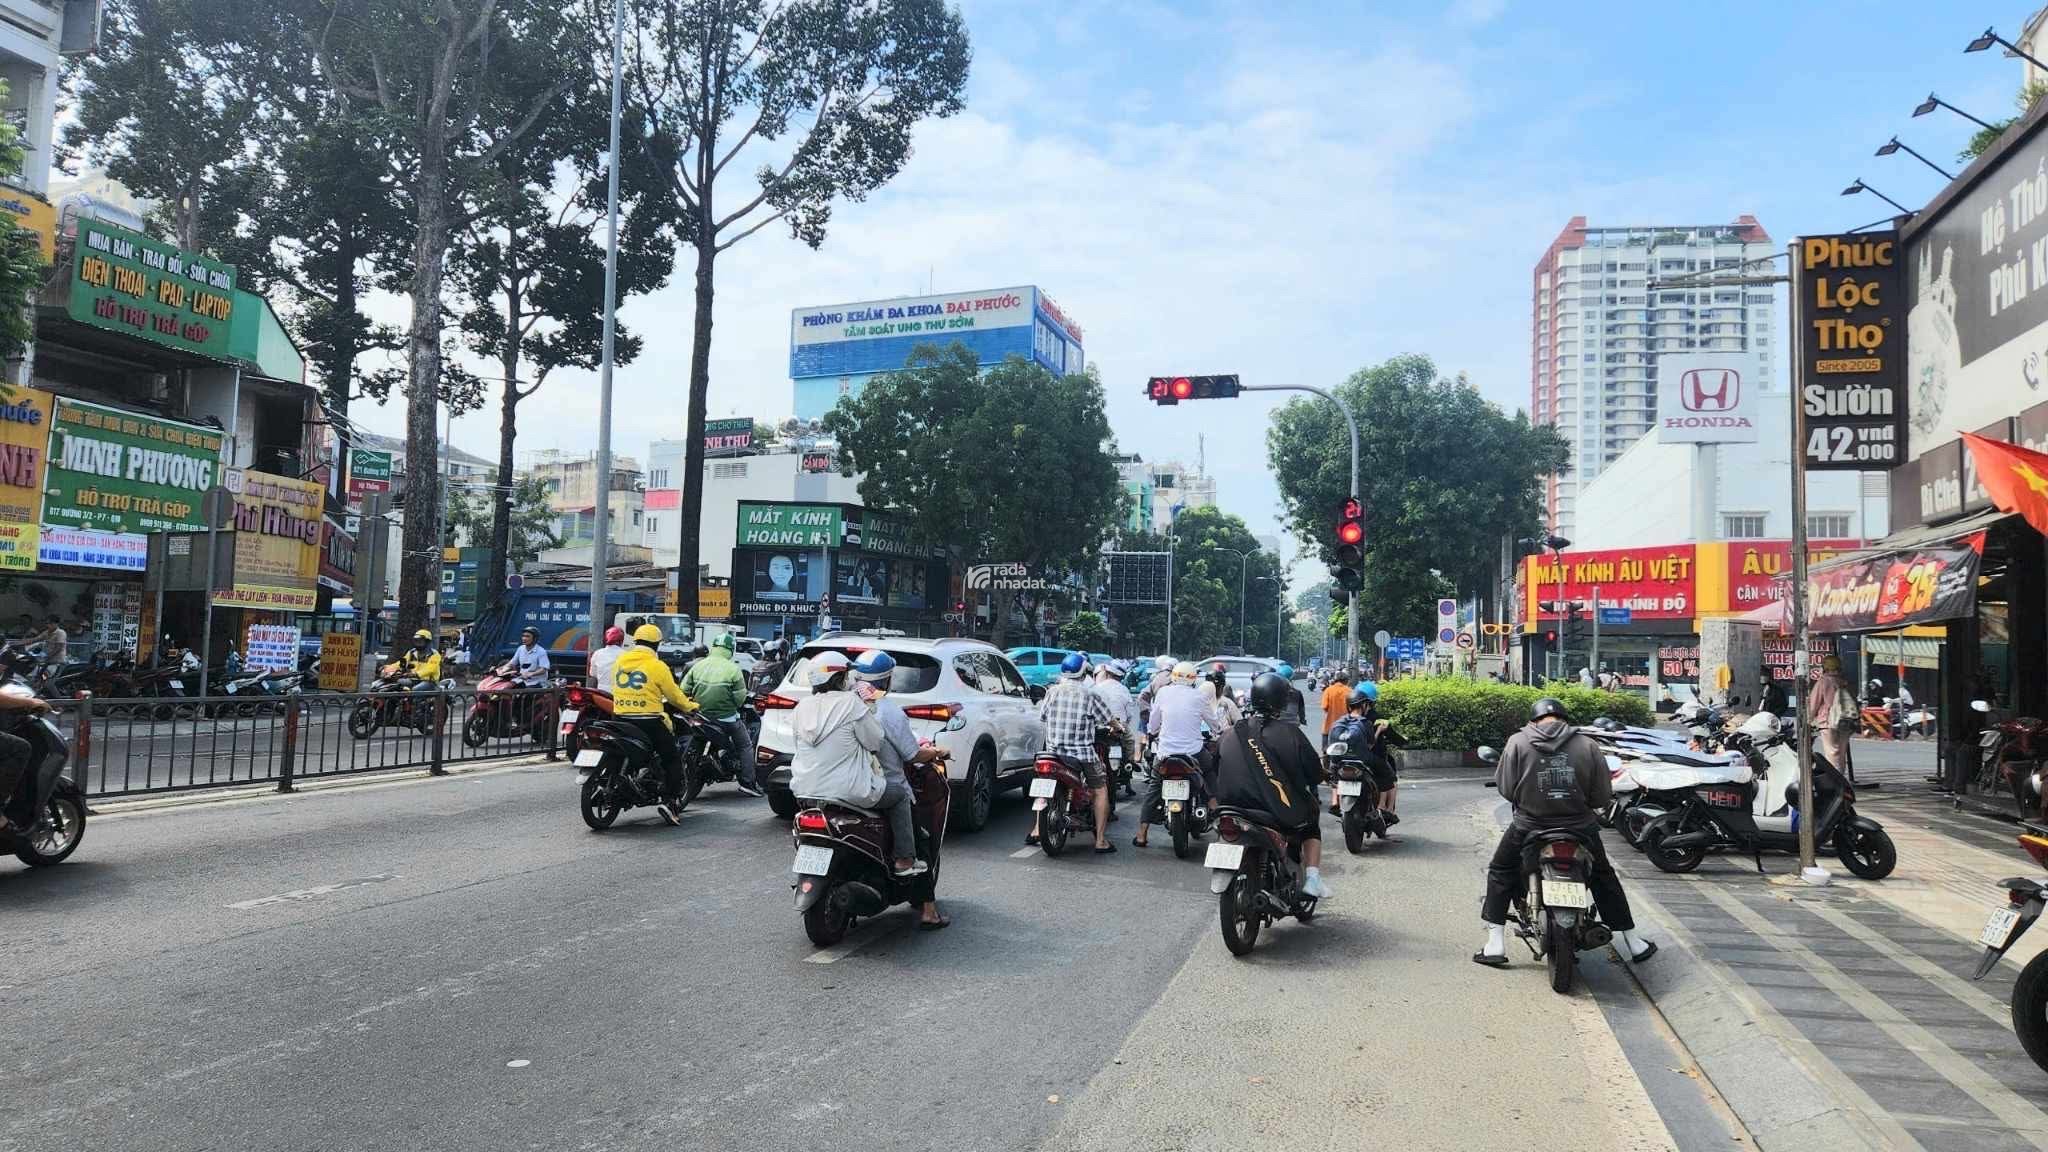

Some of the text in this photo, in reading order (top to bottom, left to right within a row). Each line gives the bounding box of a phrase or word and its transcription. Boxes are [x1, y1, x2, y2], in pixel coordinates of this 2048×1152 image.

[1981, 200, 2005, 257] Hệ
[88, 230, 231, 291] MUA BÁN TRAO ĐỔI SỬA CHỮA
[1804, 236, 1893, 270] Phúc
[82, 255, 232, 321] ĐIỆN THOẠI IPAD LAPTOP
[1816, 277, 1880, 313] Lộc
[1990, 249, 2027, 317] Phủ
[803, 293, 1021, 327] PHÒNG KHÁM ĐA KHOA ĐẠI PHƯỚC
[1813, 318, 1884, 355] Thọ
[1152, 380, 1168, 397] 21
[1804, 384, 1893, 417] Sườn
[1665, 417, 1752, 428] HONDA
[62, 435, 212, 492] MINH PHƯƠNG
[77, 485, 191, 518] HỖ TRỢ TRẢ GÓP
[749, 505, 832, 525] MẮT KÍNH
[261, 503, 320, 545] Hùng
[747, 528, 803, 545] HOÀNG
[1537, 553, 1690, 585] MẮT KÍNH ÂU VIỆT
[1743, 548, 1780, 576] ÂU
[740, 601, 771, 612] PHÒNG
[774, 603, 788, 612] ĐO
[1622, 593, 1659, 611] KÍNH
[1662, 592, 1686, 614] ĐỘ
[1737, 585, 1759, 602] CẬN
[616, 669, 647, 690] be
[1663, 660, 1683, 677] 50
